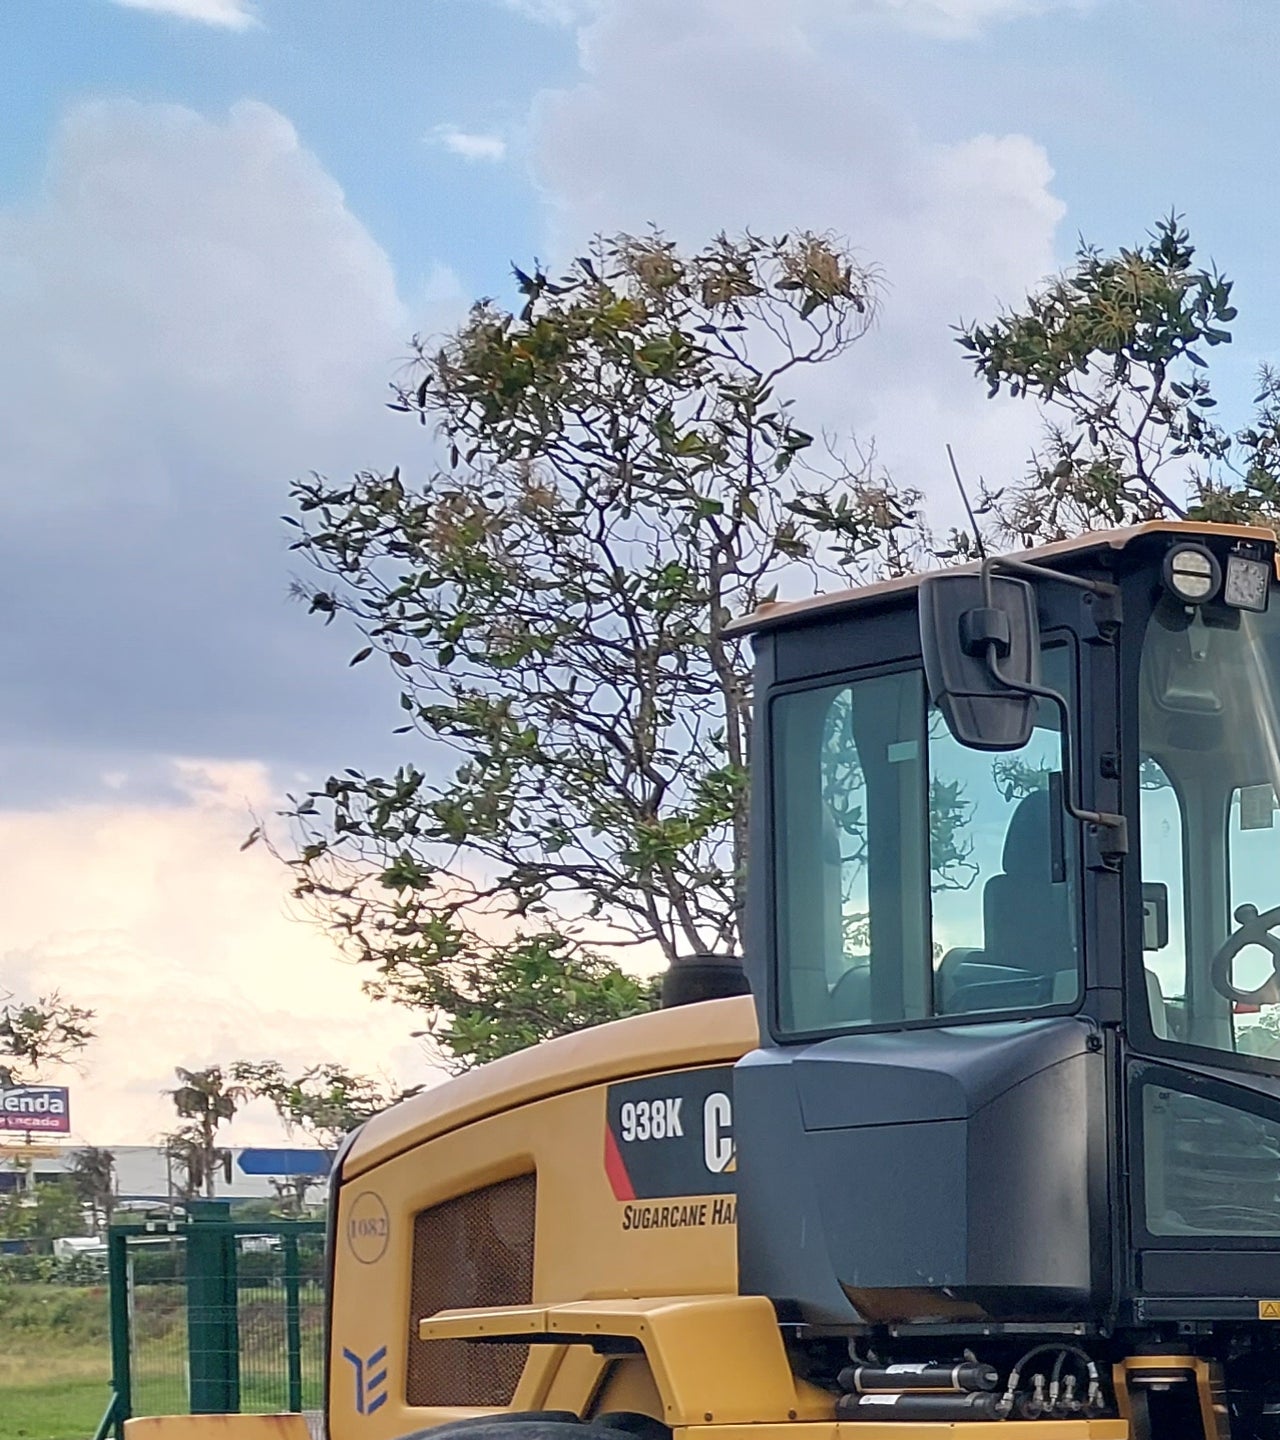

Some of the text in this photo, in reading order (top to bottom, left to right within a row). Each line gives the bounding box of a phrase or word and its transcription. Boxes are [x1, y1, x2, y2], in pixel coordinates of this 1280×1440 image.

[621, 1097, 684, 1142] 938K
[704, 1092, 736, 1173] C
[622, 1204, 707, 1230] SUGARCANE
